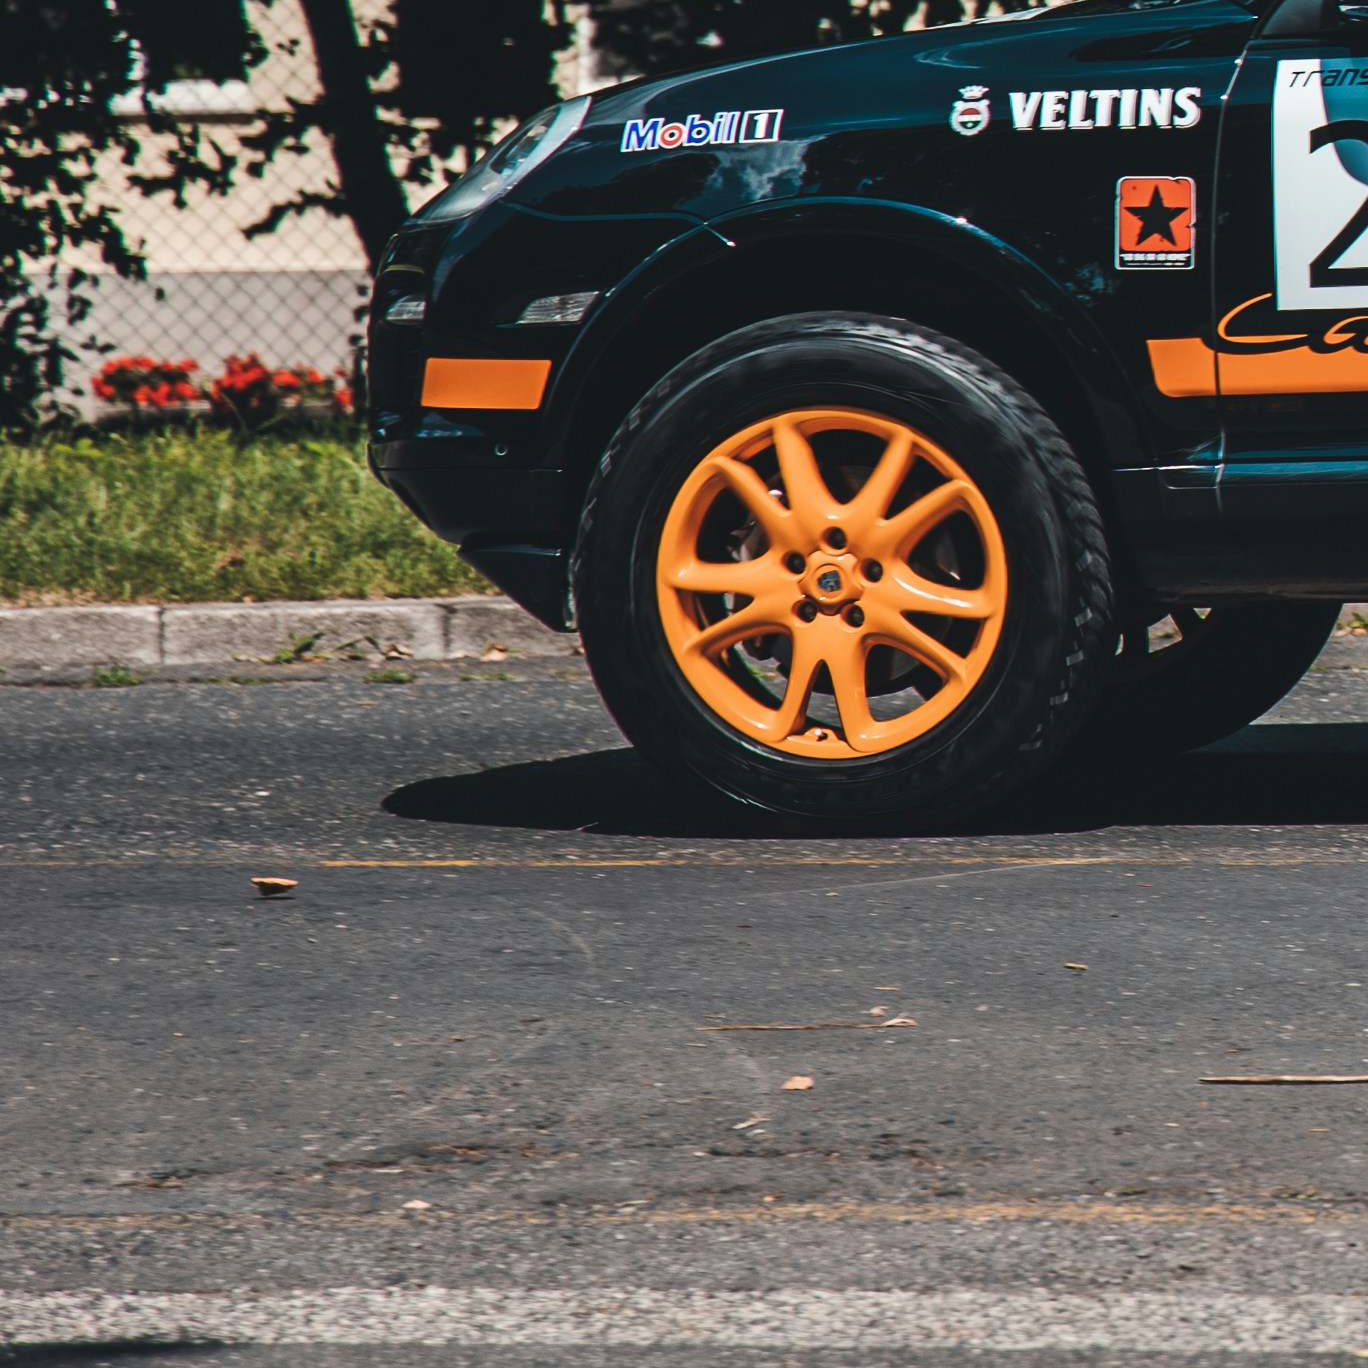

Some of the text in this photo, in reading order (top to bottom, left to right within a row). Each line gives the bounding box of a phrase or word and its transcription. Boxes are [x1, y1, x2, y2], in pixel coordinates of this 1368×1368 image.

[1008, 87, 1202, 130] VELTINS
[620, 111, 772, 152] Mobil 1
